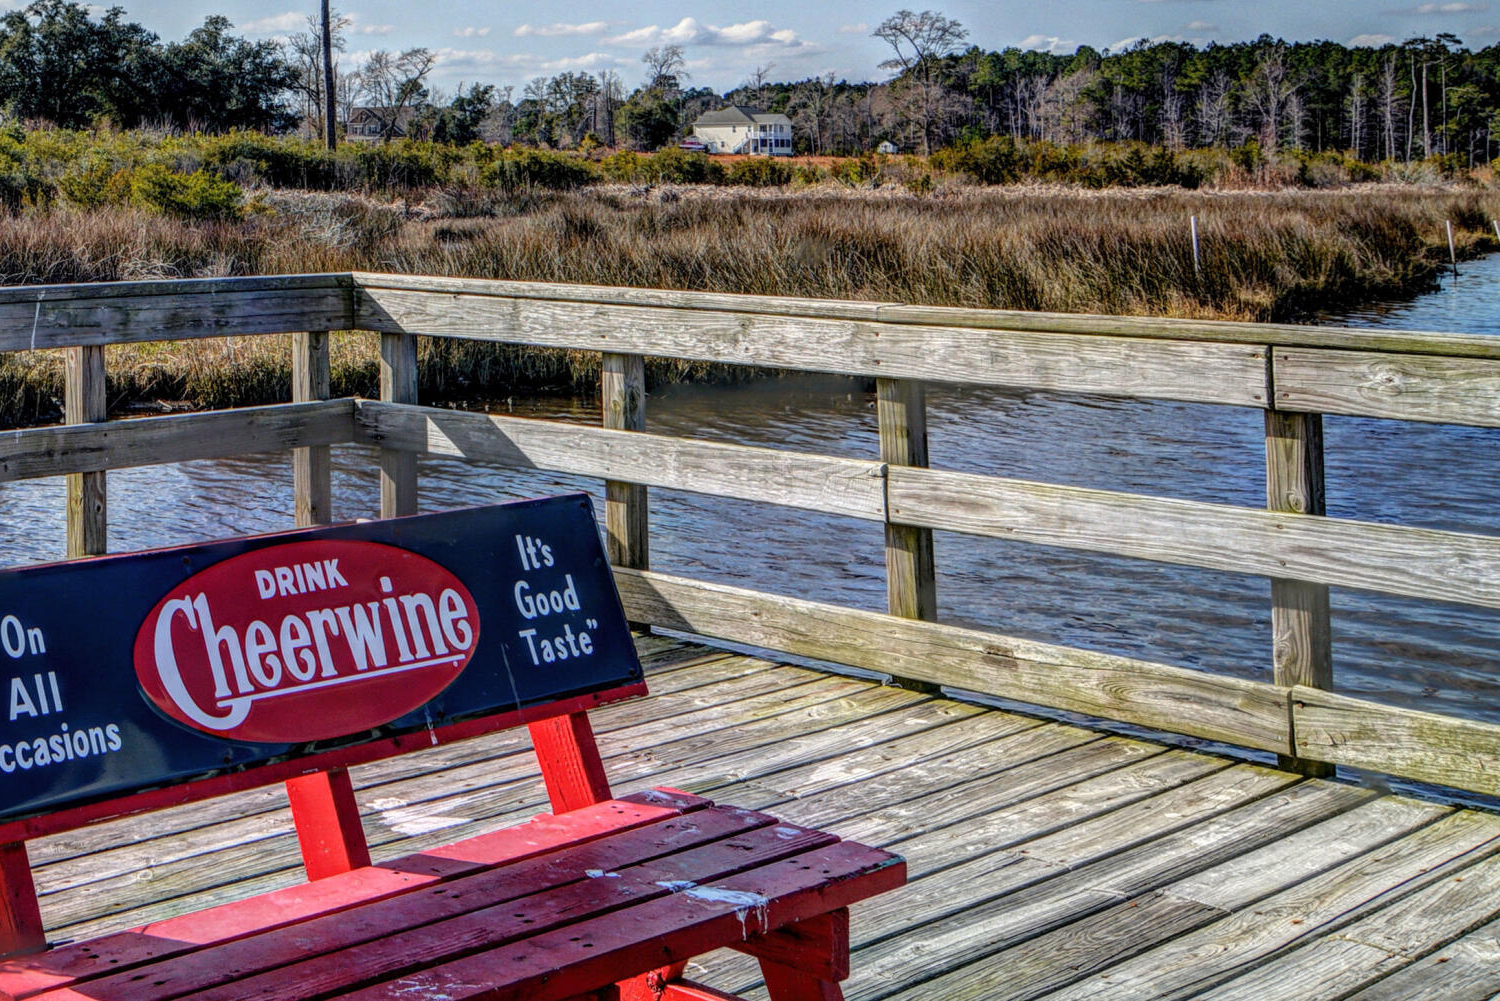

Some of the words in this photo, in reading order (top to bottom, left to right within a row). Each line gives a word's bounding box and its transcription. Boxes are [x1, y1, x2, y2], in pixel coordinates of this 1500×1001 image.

[516, 535, 555, 571] It’s
[255, 559, 349, 600] DRINK
[514, 574, 581, 620] Good
[154, 576, 473, 730] Cheerwine
[518, 618, 598, 666] Taste”
[9, 671, 64, 721] All
